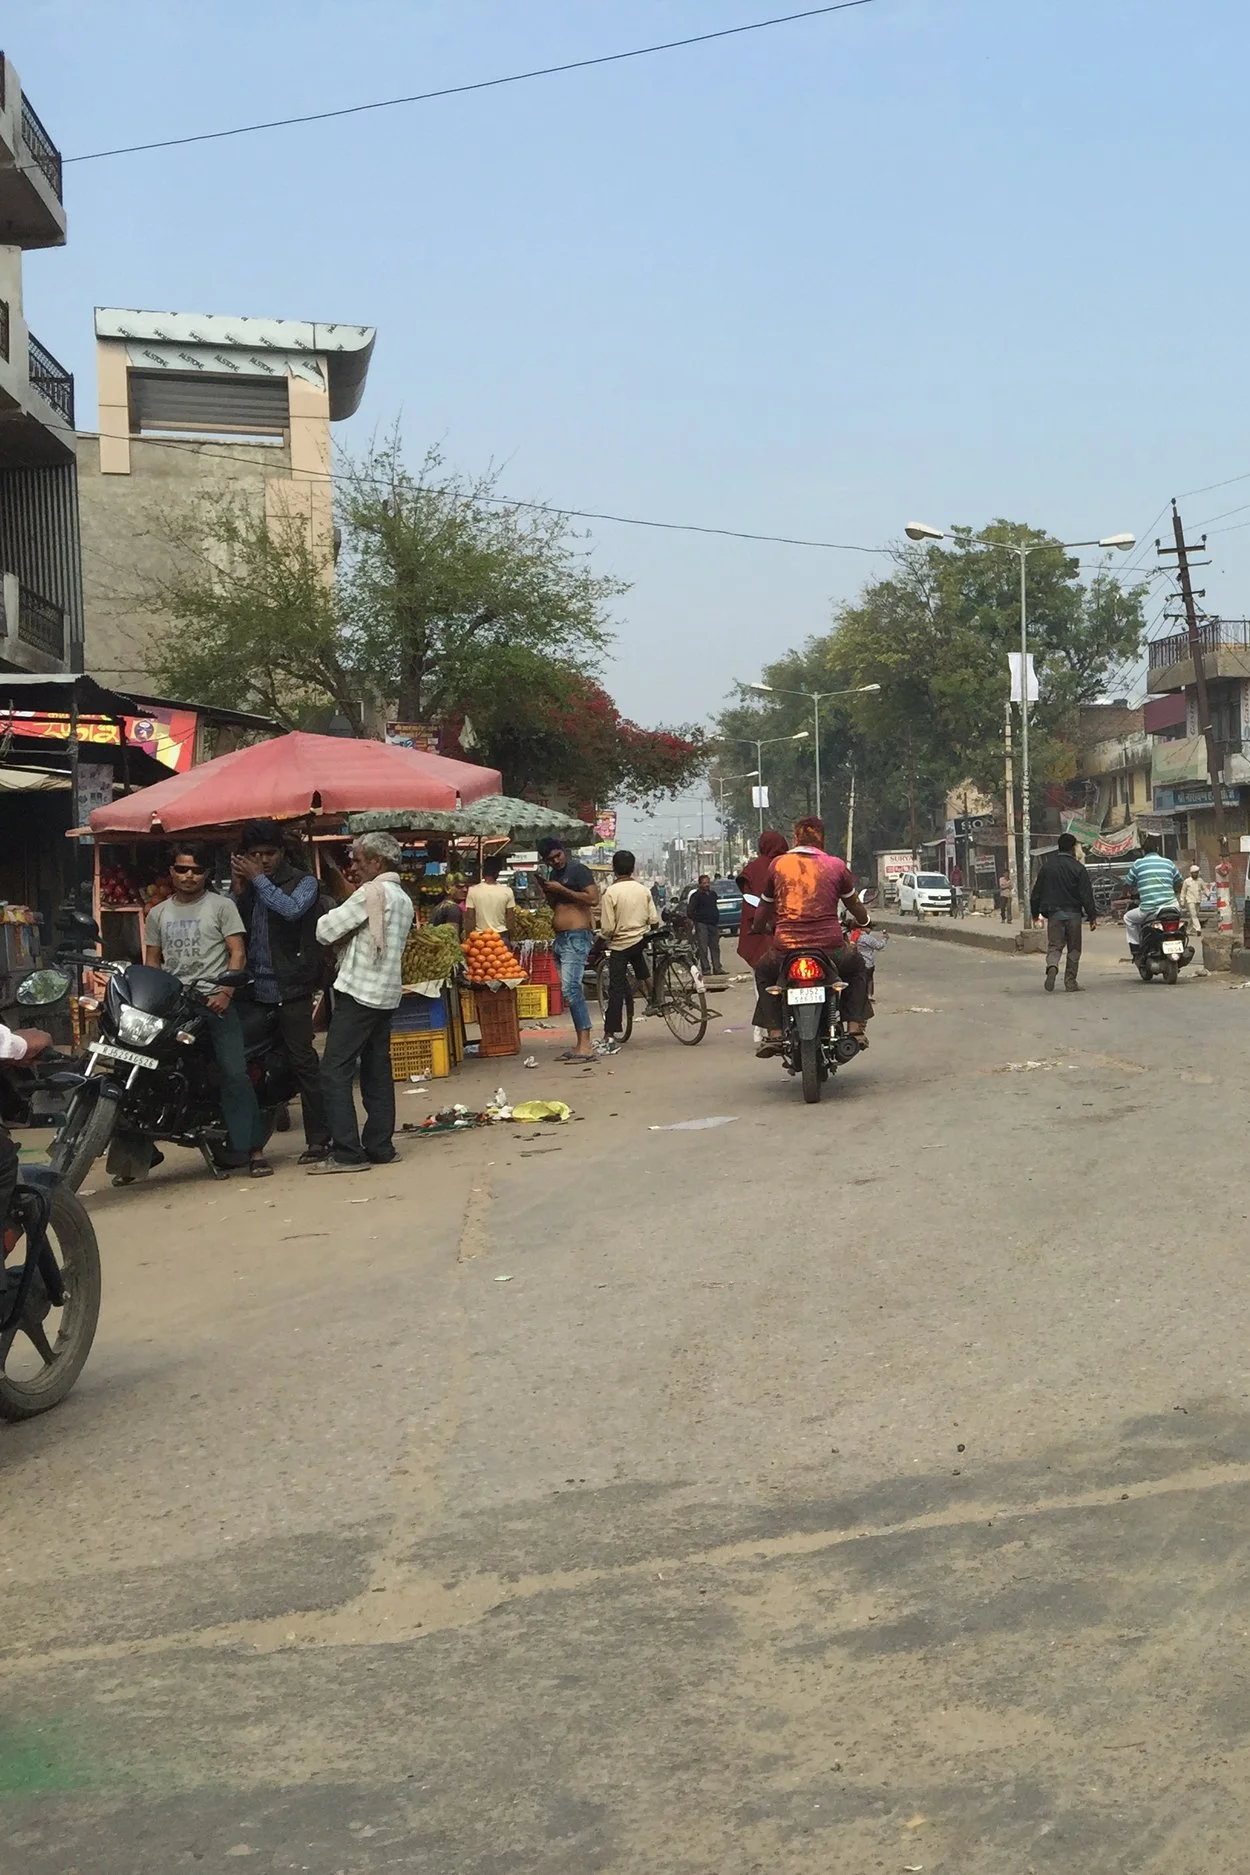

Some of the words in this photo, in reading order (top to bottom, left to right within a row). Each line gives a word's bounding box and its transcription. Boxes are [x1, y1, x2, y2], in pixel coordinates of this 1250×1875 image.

[142, 349, 170, 368] ALSTONE
[178, 352, 205, 370] ALSTONE
[214, 354, 240, 373] ALSTONE
[249, 357, 276, 376] ALSTONE
[166, 938, 201, 950] ROCK
[166, 947, 201, 958] STAR
